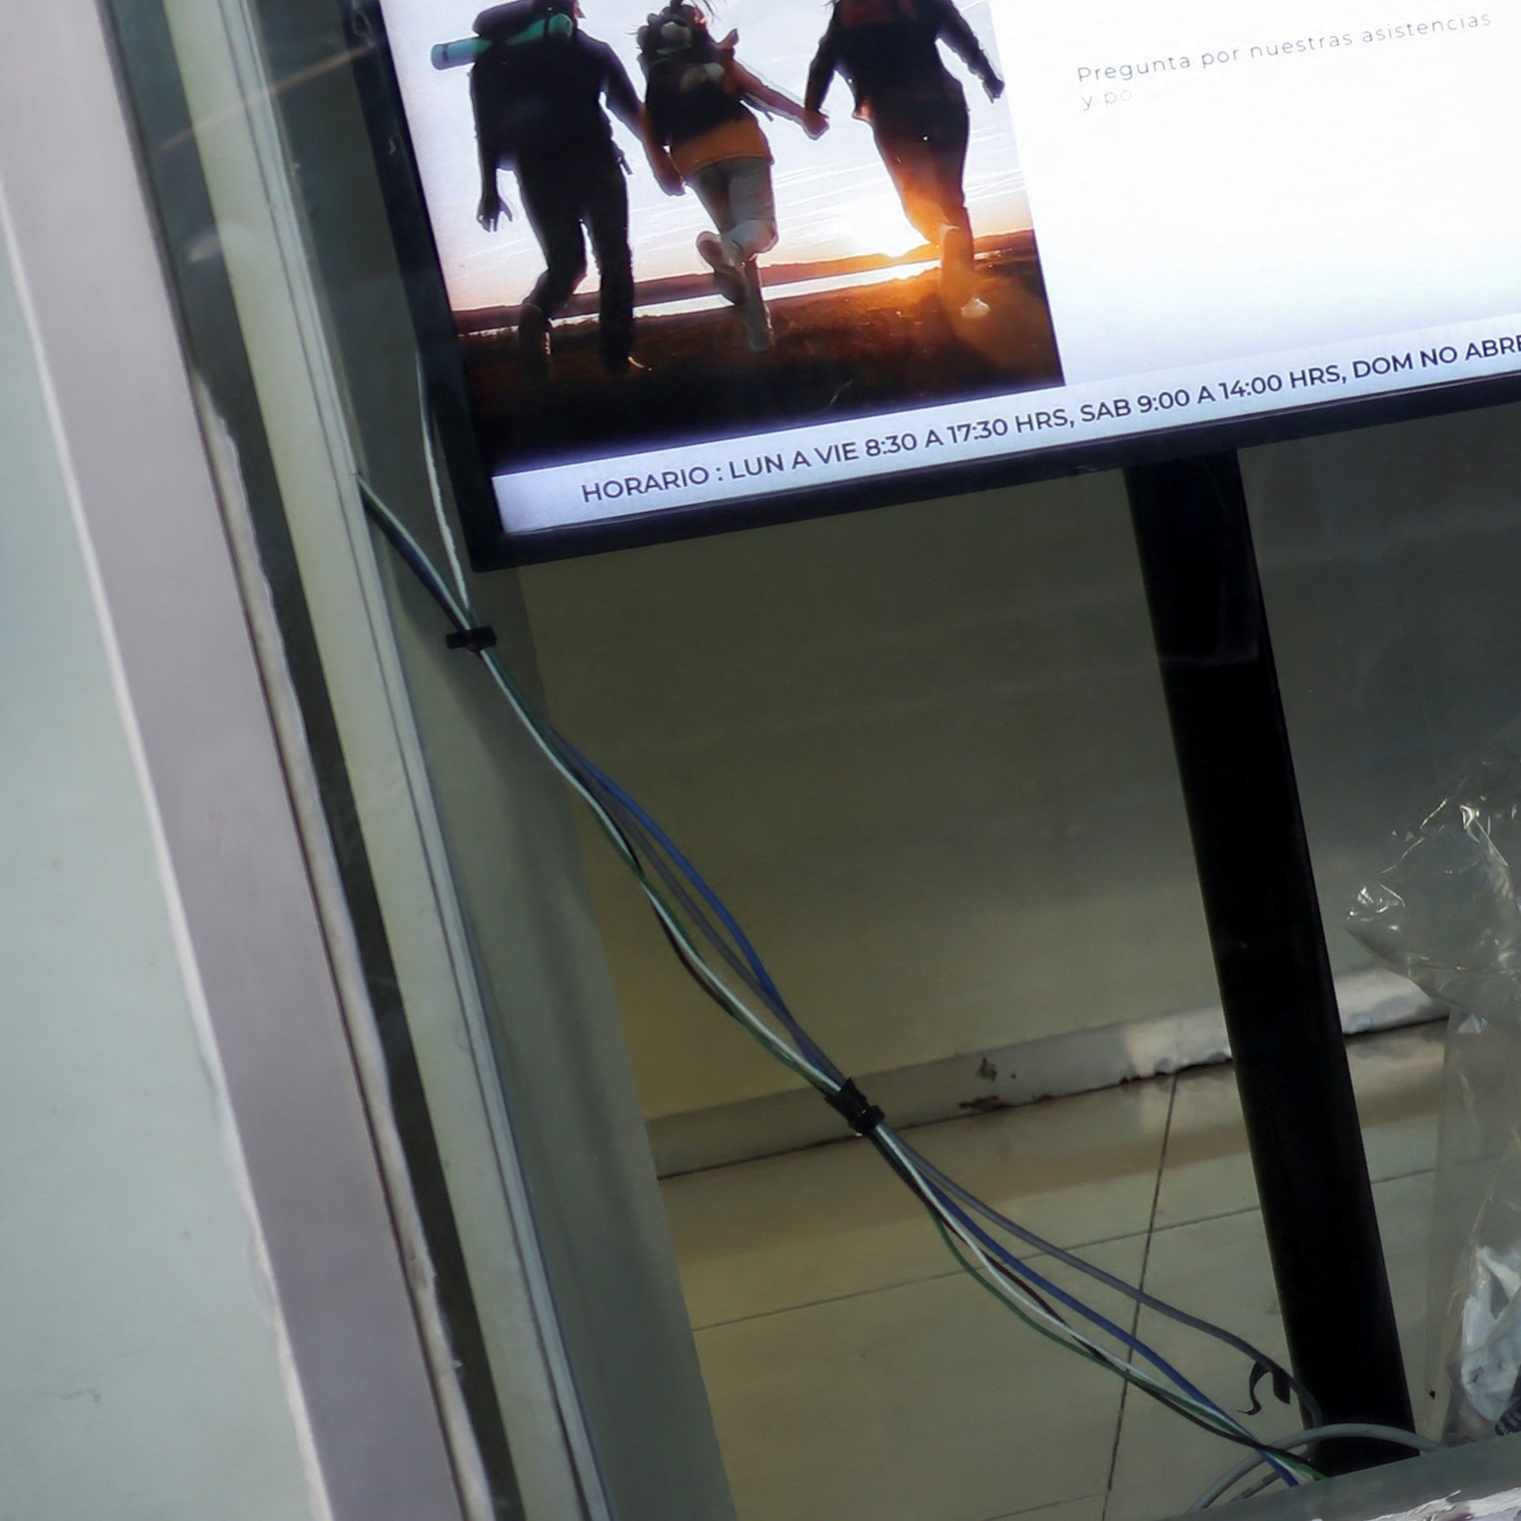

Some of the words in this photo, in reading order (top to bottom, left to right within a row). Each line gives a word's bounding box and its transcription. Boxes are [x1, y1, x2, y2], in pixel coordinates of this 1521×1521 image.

[1077, 54, 1192, 83] Pregunta
[1200, 46, 1239, 69] por
[1249, 31, 1353, 59] nuestras
[1361, 11, 1493, 44] asistencias
[581, 465, 711, 504] HORARIO
[728, 452, 785, 481] LUN
[791, 450, 811, 471] A
[813, 441, 860, 465] VIE
[864, 433, 918, 459] 8:30
[923, 428, 944, 449] A
[947, 417, 1008, 445] 17:30
[1014, 407, 1075, 434] HRS,
[1080, 398, 1132, 424] SAB
[1136, 389, 1190, 414] 9:00
[1196, 384, 1217, 406] A
[1218, 374, 1283, 401] 14:00
[1288, 364, 1349, 391] HRS,
[1352, 353, 1413, 380] DOM
[1419, 345, 1458, 368] NO
